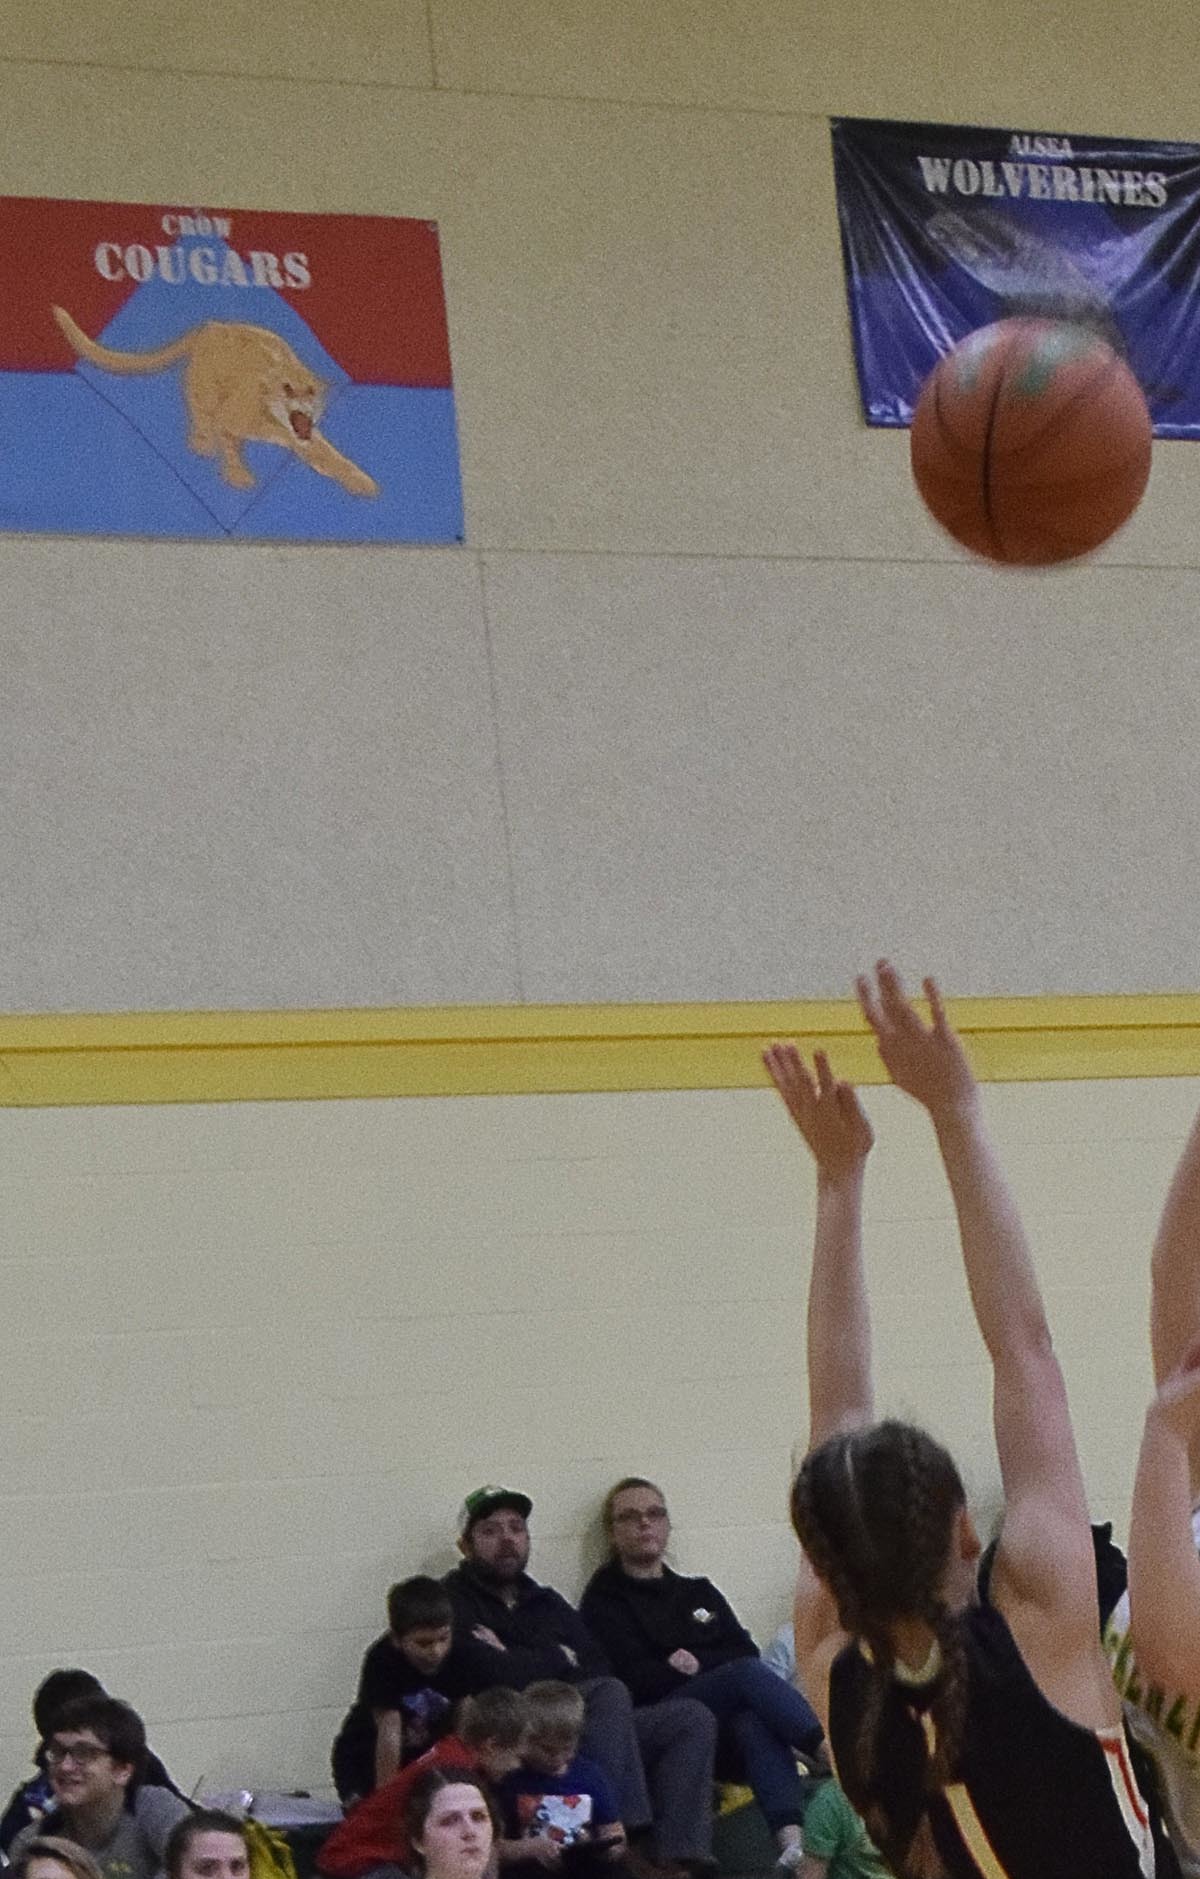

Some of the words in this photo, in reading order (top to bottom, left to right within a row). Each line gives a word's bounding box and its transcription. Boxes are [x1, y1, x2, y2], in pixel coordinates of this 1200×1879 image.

[1007, 134, 1075, 158] ALSEA
[917, 155, 1169, 208] WOLVERINES
[161, 214, 233, 239] CROW
[93, 241, 312, 289] COUGARS
